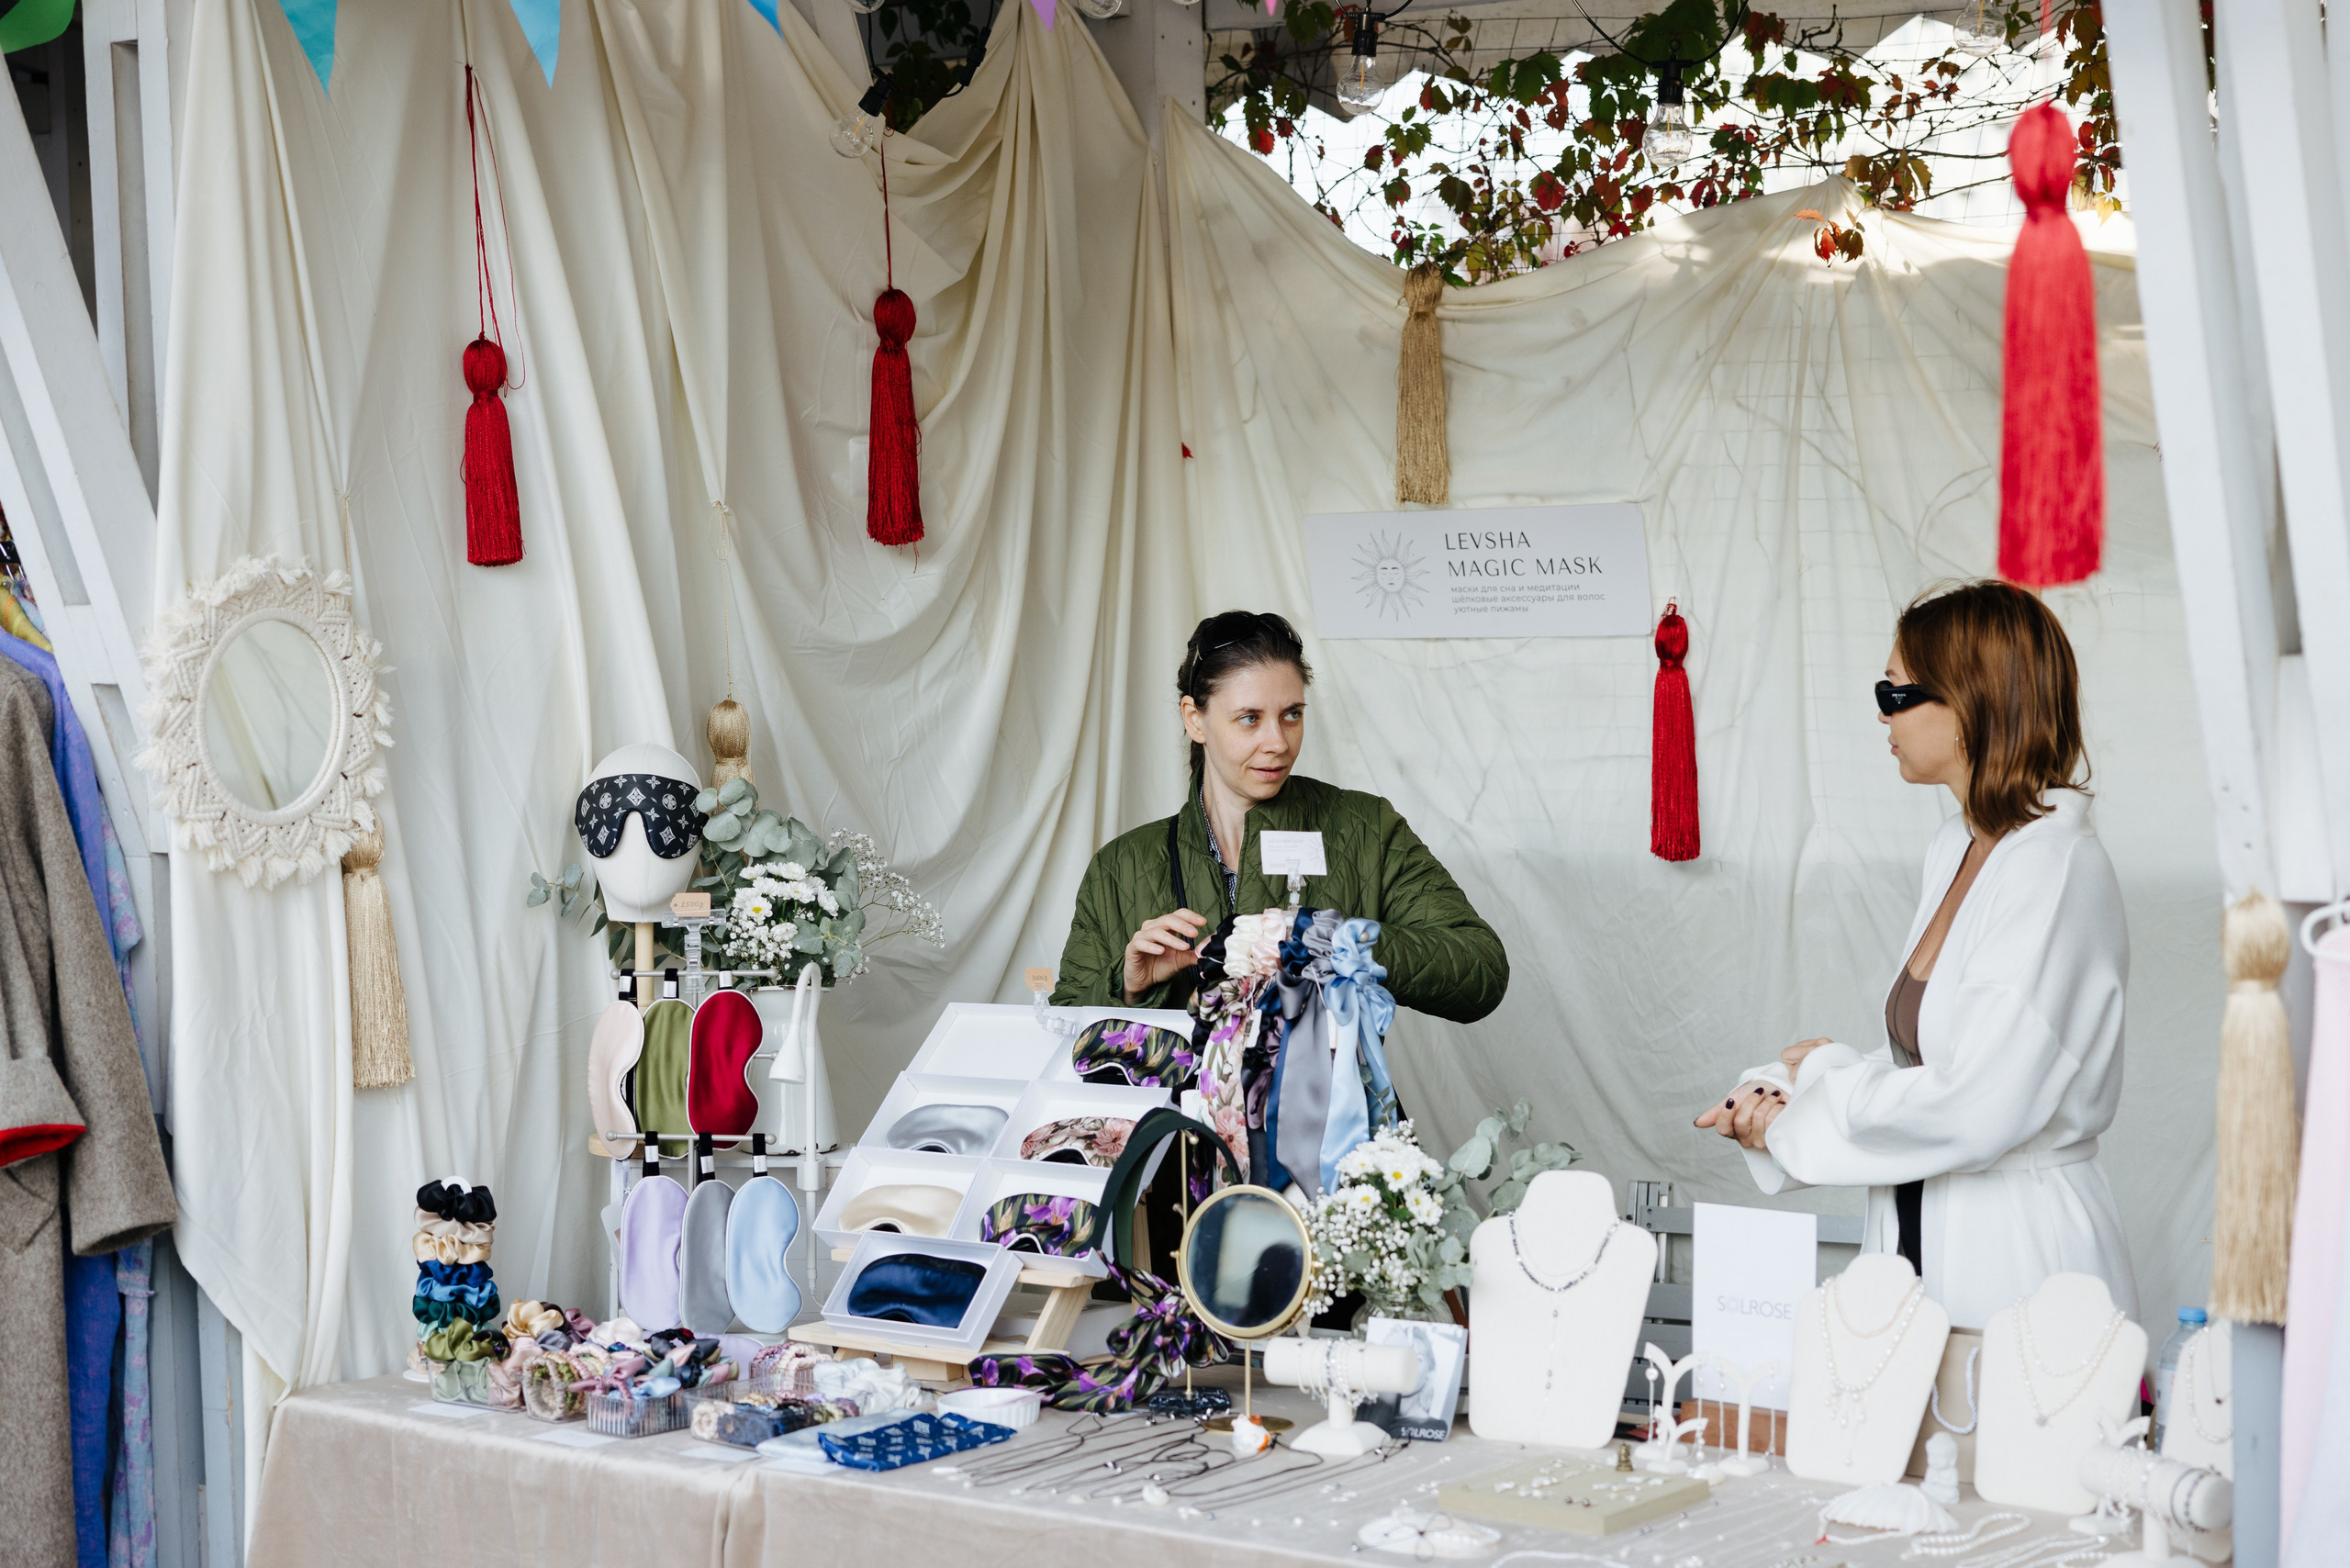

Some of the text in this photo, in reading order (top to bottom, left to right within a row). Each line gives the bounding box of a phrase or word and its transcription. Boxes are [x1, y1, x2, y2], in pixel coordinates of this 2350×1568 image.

[1445, 532, 1530, 550] LEVSHA
[1448, 556, 1602, 577] MAGIC MASK
[1527, 584, 1581, 592] медитации
[1501, 595, 1555, 604] аксессуары
[1557, 594, 1574, 602] для
[1577, 593, 1606, 601] волос
[1453, 606, 1489, 616] уютные
